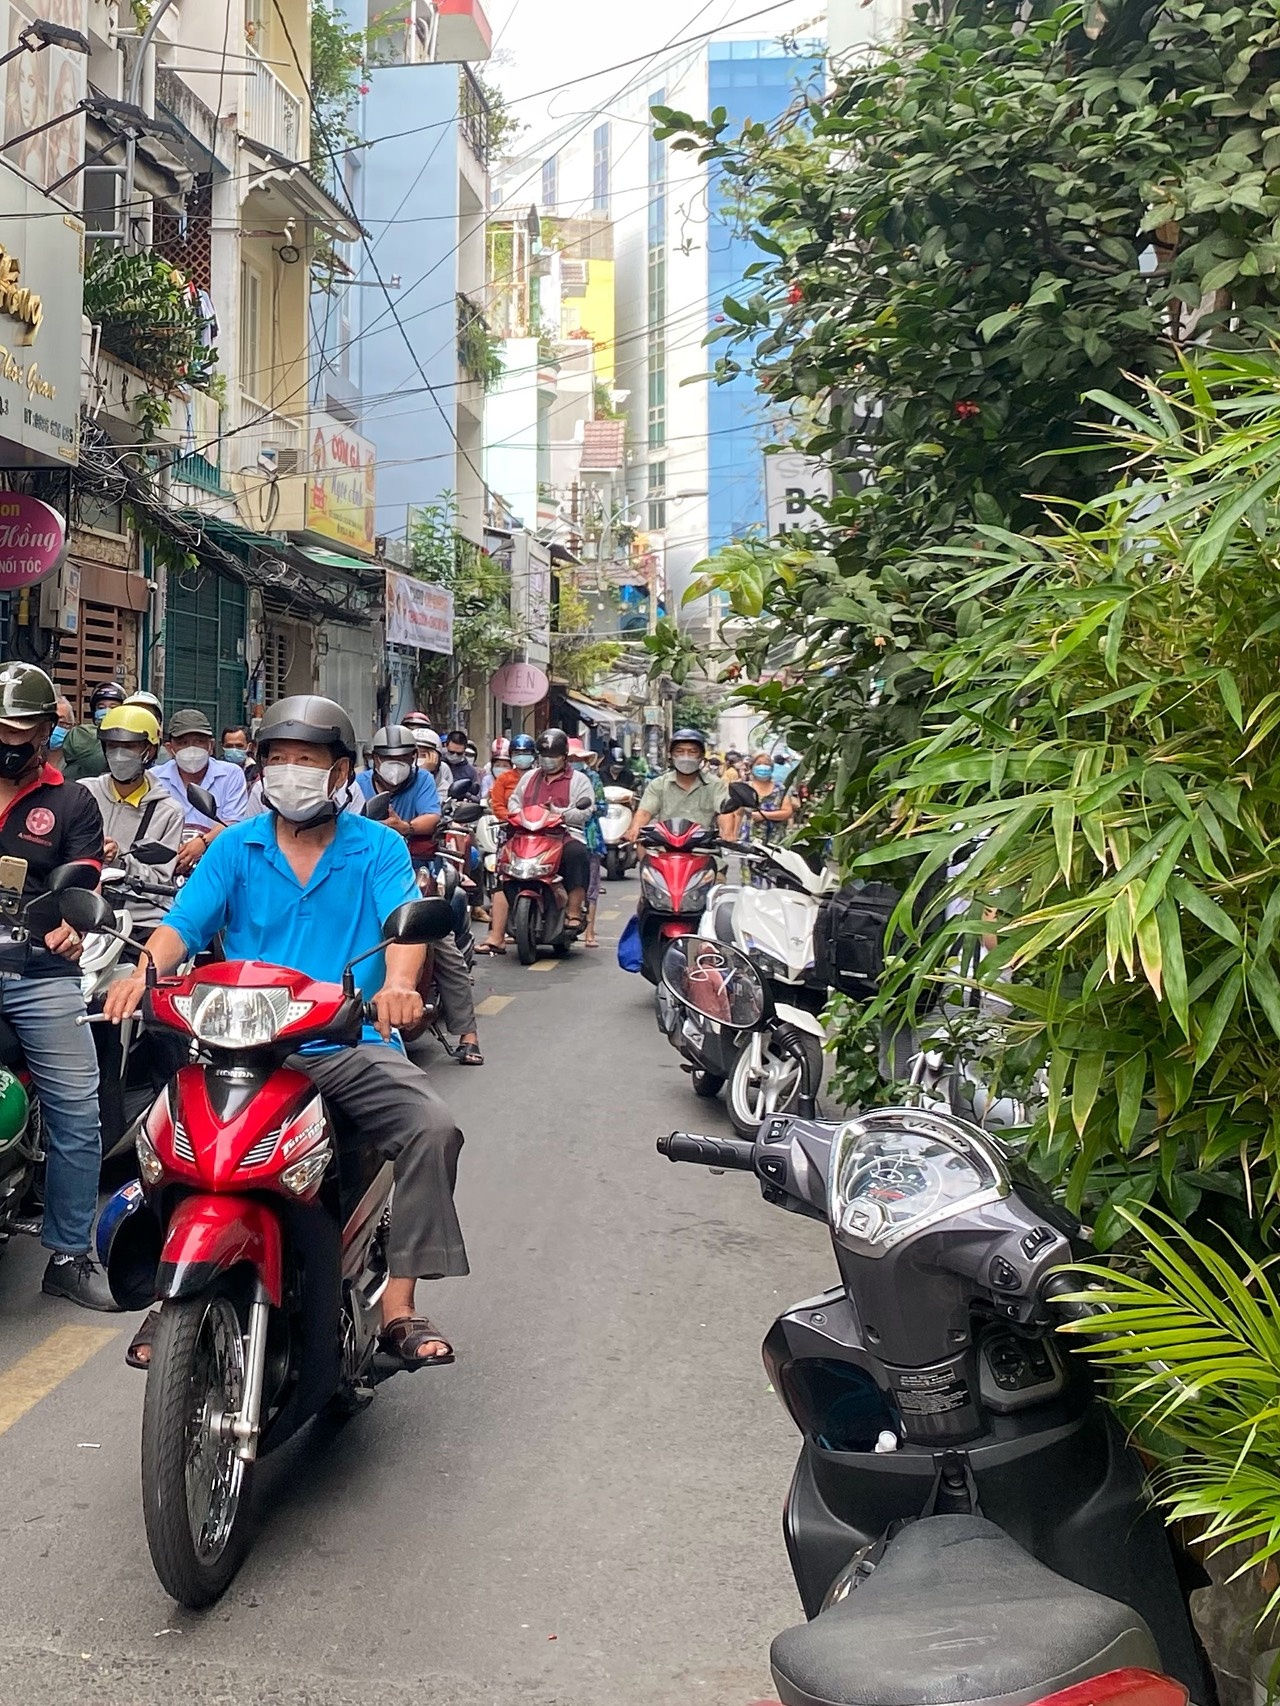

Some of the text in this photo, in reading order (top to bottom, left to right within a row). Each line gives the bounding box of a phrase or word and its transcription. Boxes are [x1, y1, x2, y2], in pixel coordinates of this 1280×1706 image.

[26, 362, 56, 402] Gian
[331, 433, 349, 465] CƠM
[21, 557, 42, 573] TÓC
